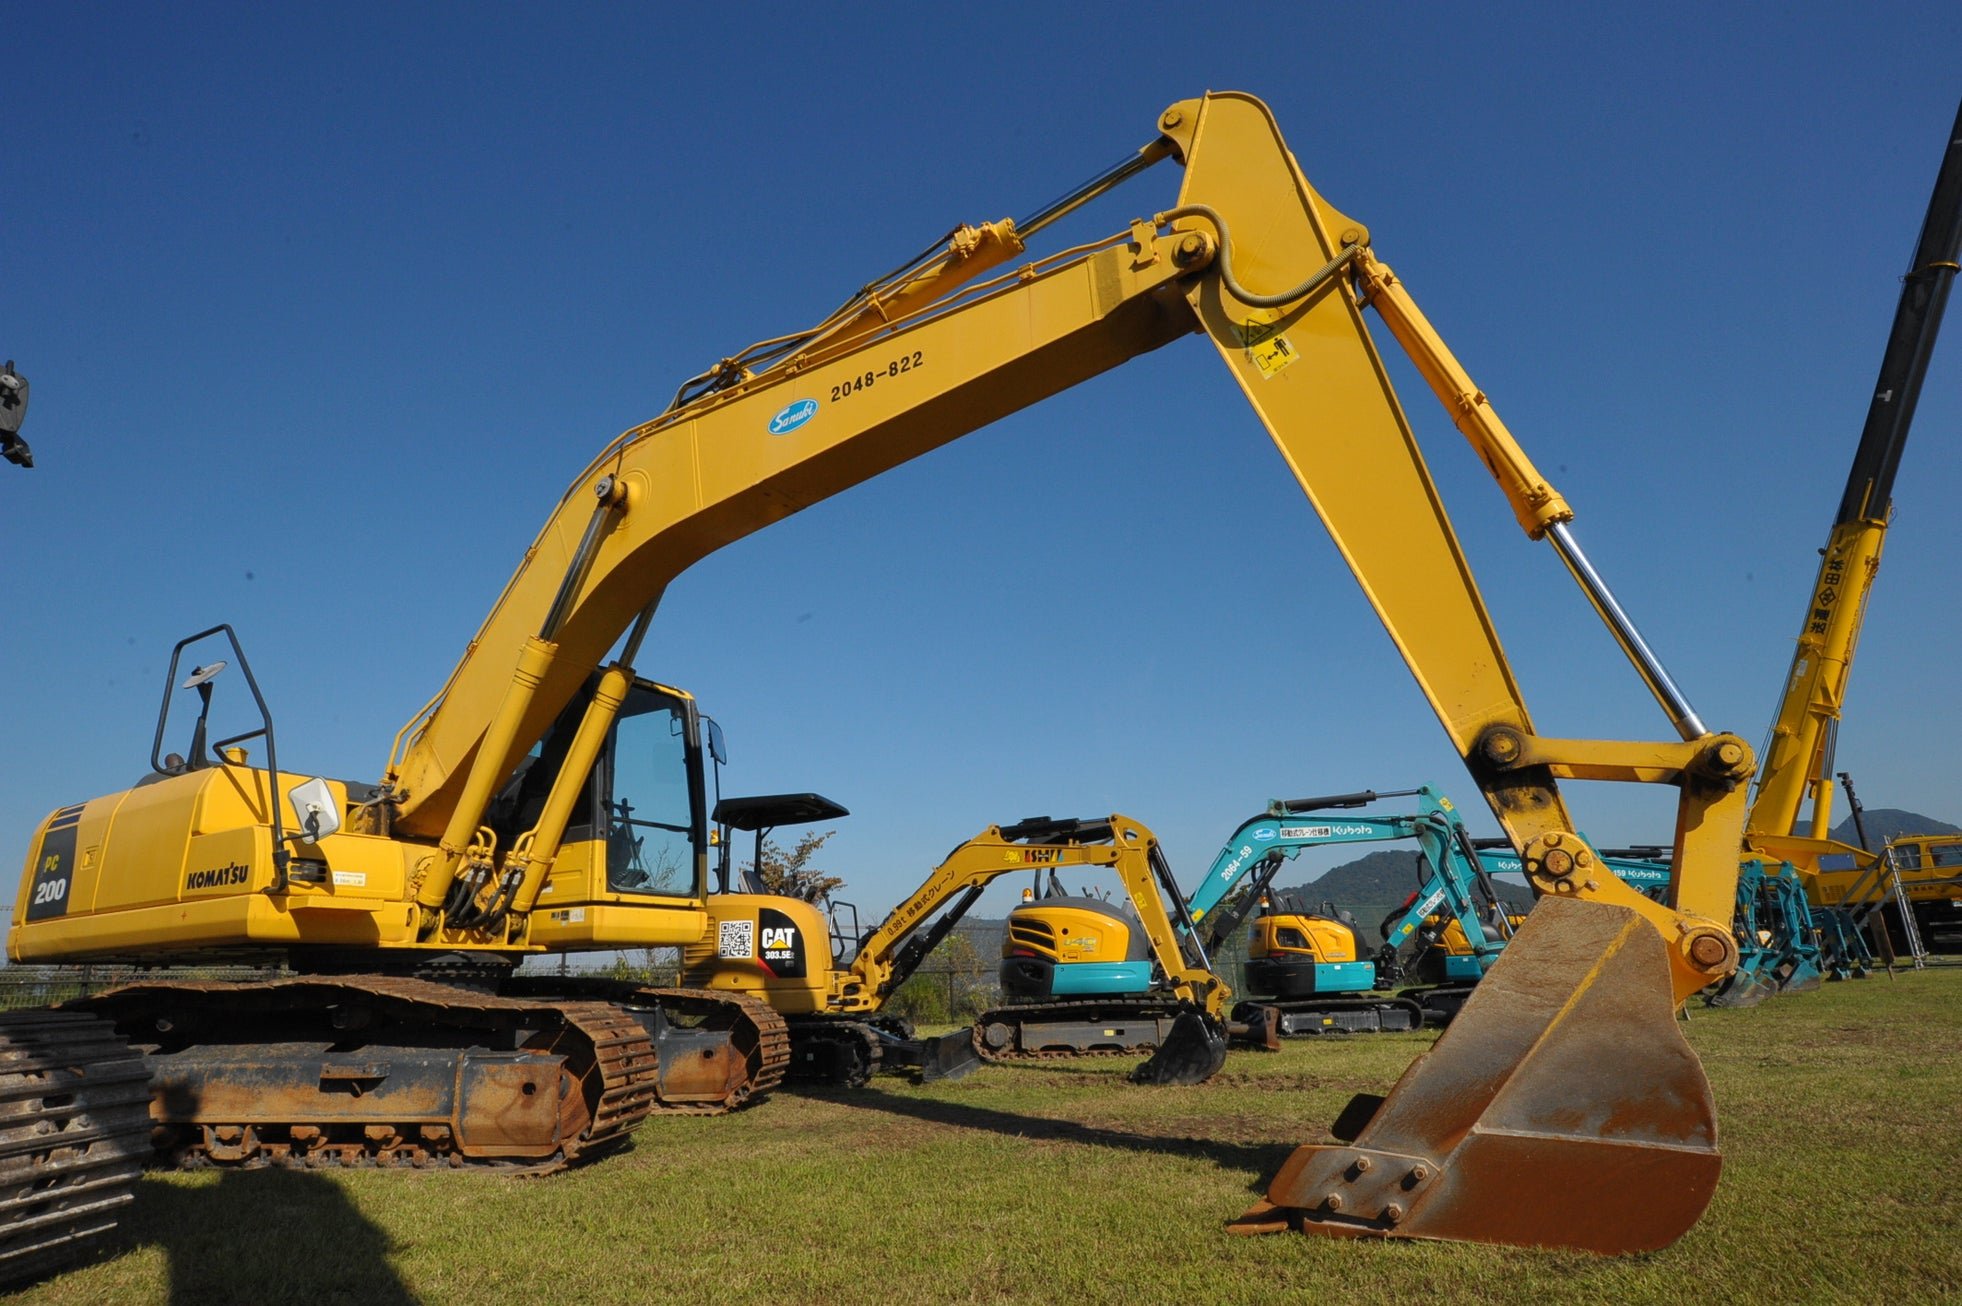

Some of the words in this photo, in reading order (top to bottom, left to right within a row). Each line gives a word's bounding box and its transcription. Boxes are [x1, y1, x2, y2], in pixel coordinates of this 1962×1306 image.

[831, 351, 923, 402] 2048-822
[771, 401, 815, 432] Sanuki
[1333, 825, 1373, 836] Kubota
[43, 854, 60, 873] PC
[1628, 870, 1662, 879] Kubota
[186, 862, 249, 890] KOMATSU
[34, 878, 67, 905] 200
[762, 928, 795, 949] CAT
